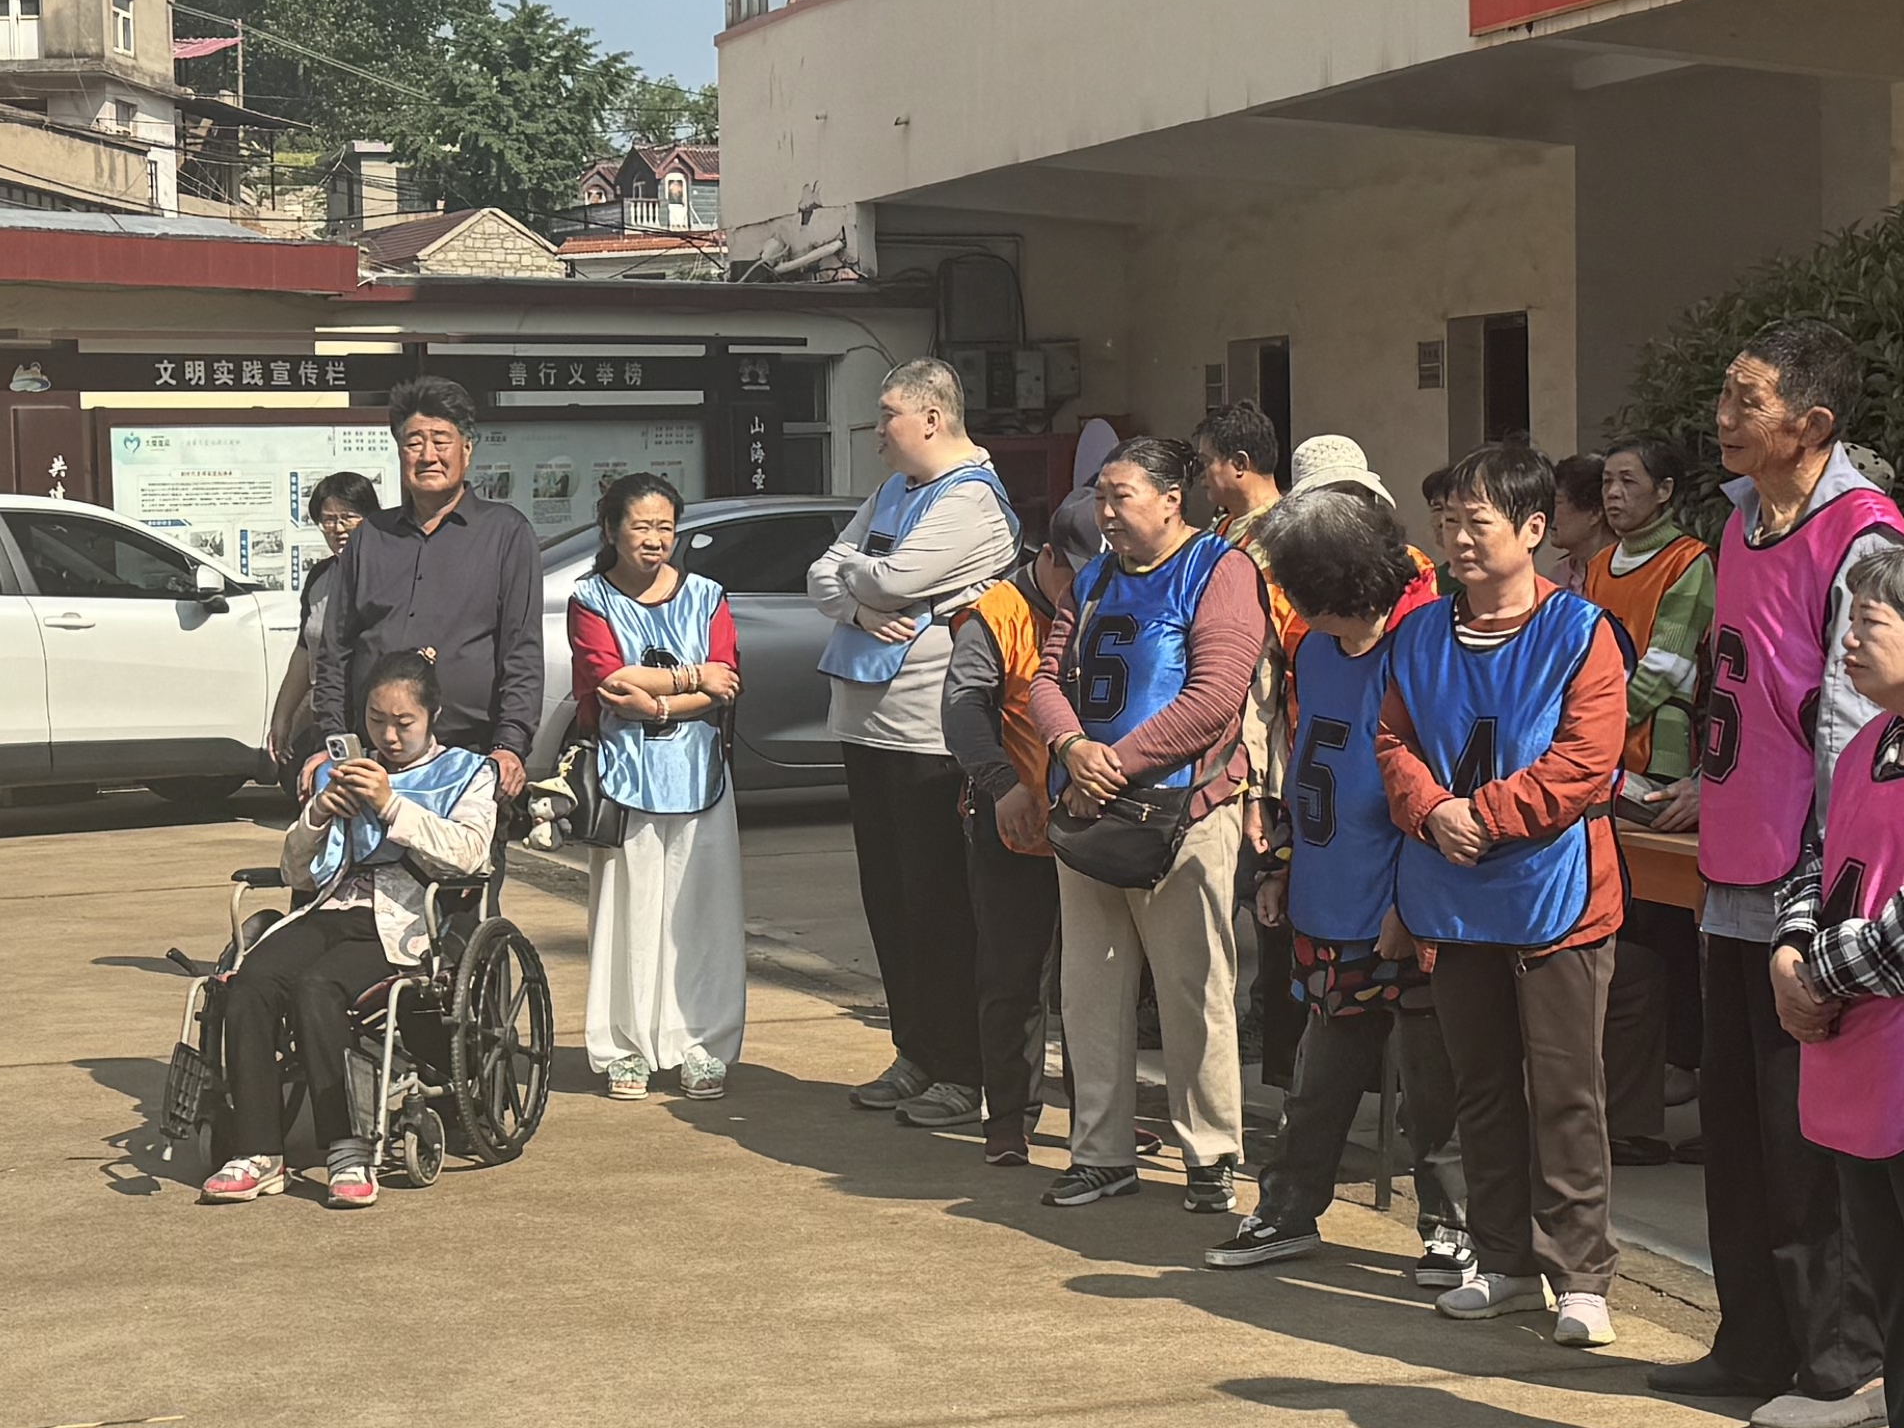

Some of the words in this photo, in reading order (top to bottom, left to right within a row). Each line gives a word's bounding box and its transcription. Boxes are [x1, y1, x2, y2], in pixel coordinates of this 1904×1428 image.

[155, 360, 346, 386] 文明实践宣传栏
[509, 361, 643, 386] 善行义举榜
[1081, 613, 1142, 724] 6
[1700, 624, 1748, 784] 6
[1296, 714, 1352, 848] 5
